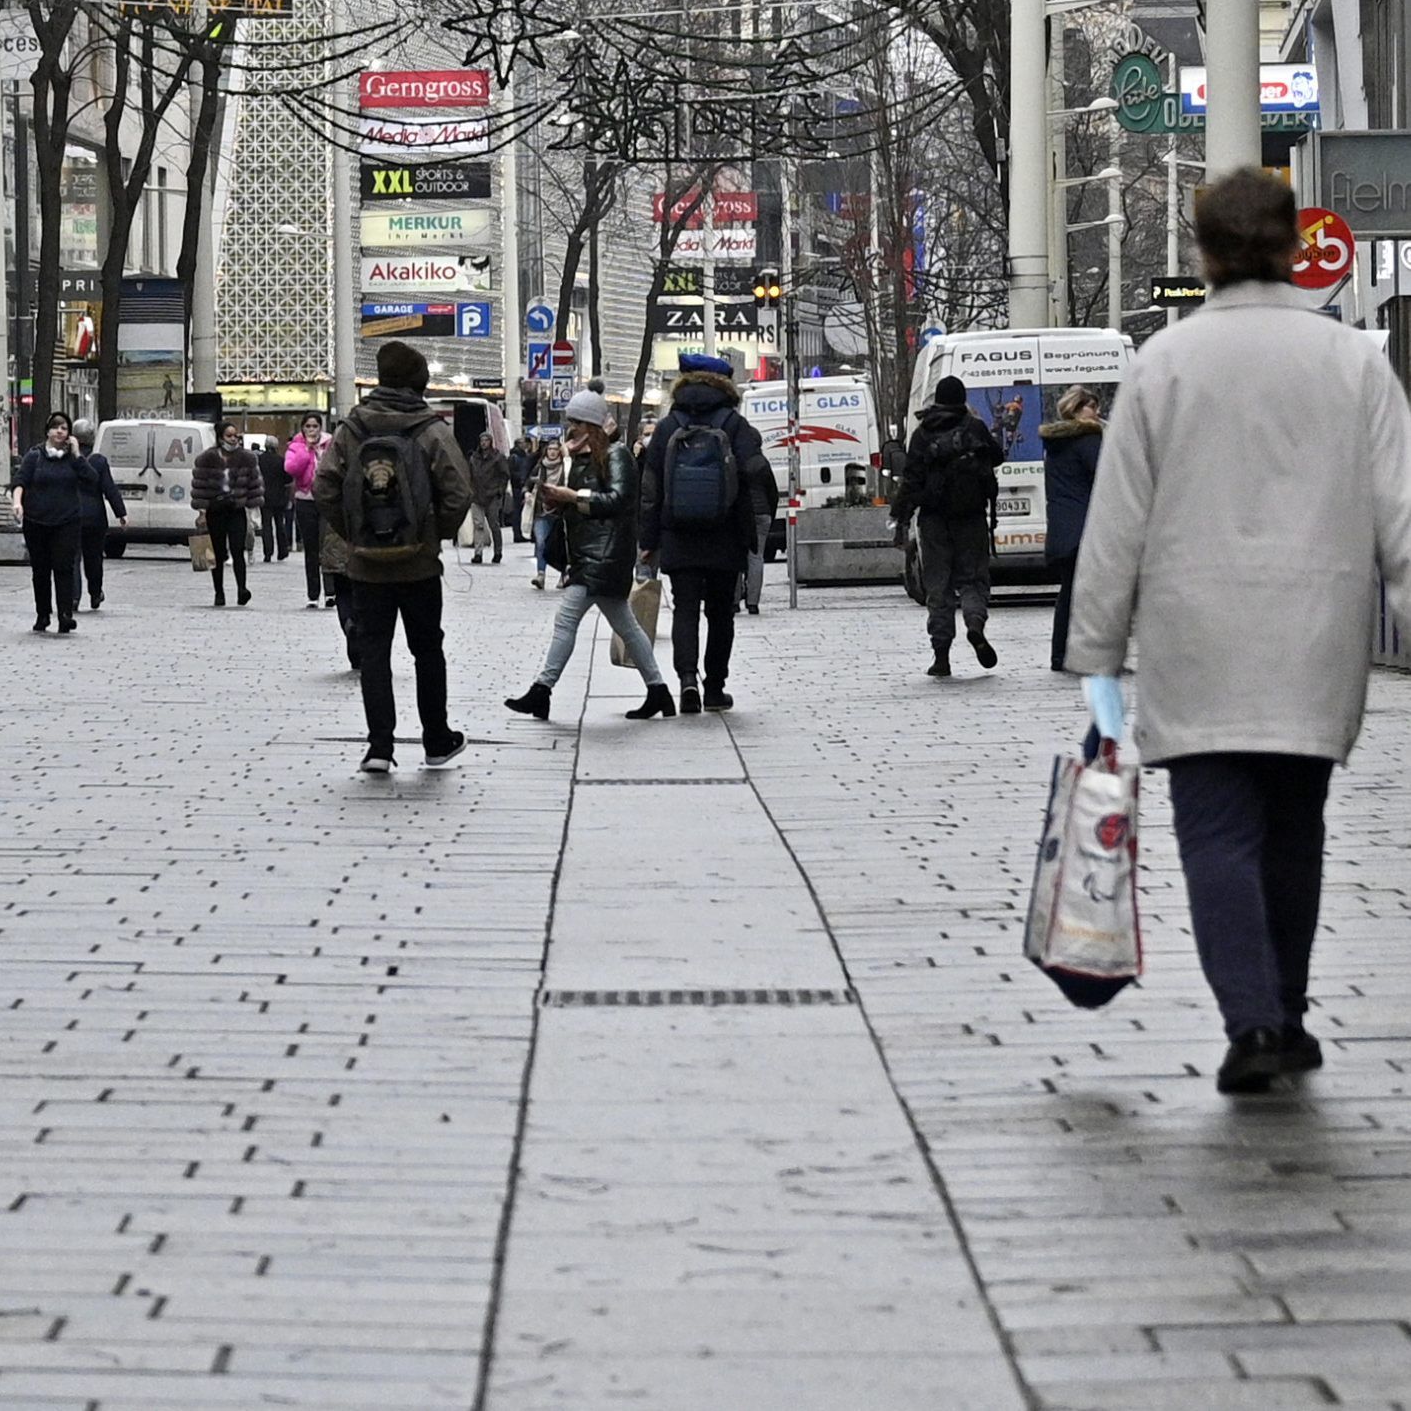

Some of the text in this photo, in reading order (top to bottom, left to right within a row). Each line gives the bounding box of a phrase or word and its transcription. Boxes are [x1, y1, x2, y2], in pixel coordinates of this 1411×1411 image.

[366, 75, 483, 103] Gerngross
[362, 125, 418, 144] Media
[372, 170, 413, 193] XXL
[415, 169, 453, 181] SPORTS
[415, 182, 470, 193] OUTDOOR
[389, 216, 463, 230] MERKUR
[369, 262, 457, 280] Akakiko
[373, 305, 413, 314] GARAGE
[666, 311, 750, 326] ZARA
[961, 350, 1119, 363] FAGUS Begrünung
[751, 400, 788, 413] TICH
[817, 395, 859, 409] GLAS
[165, 436, 193, 462] A1
